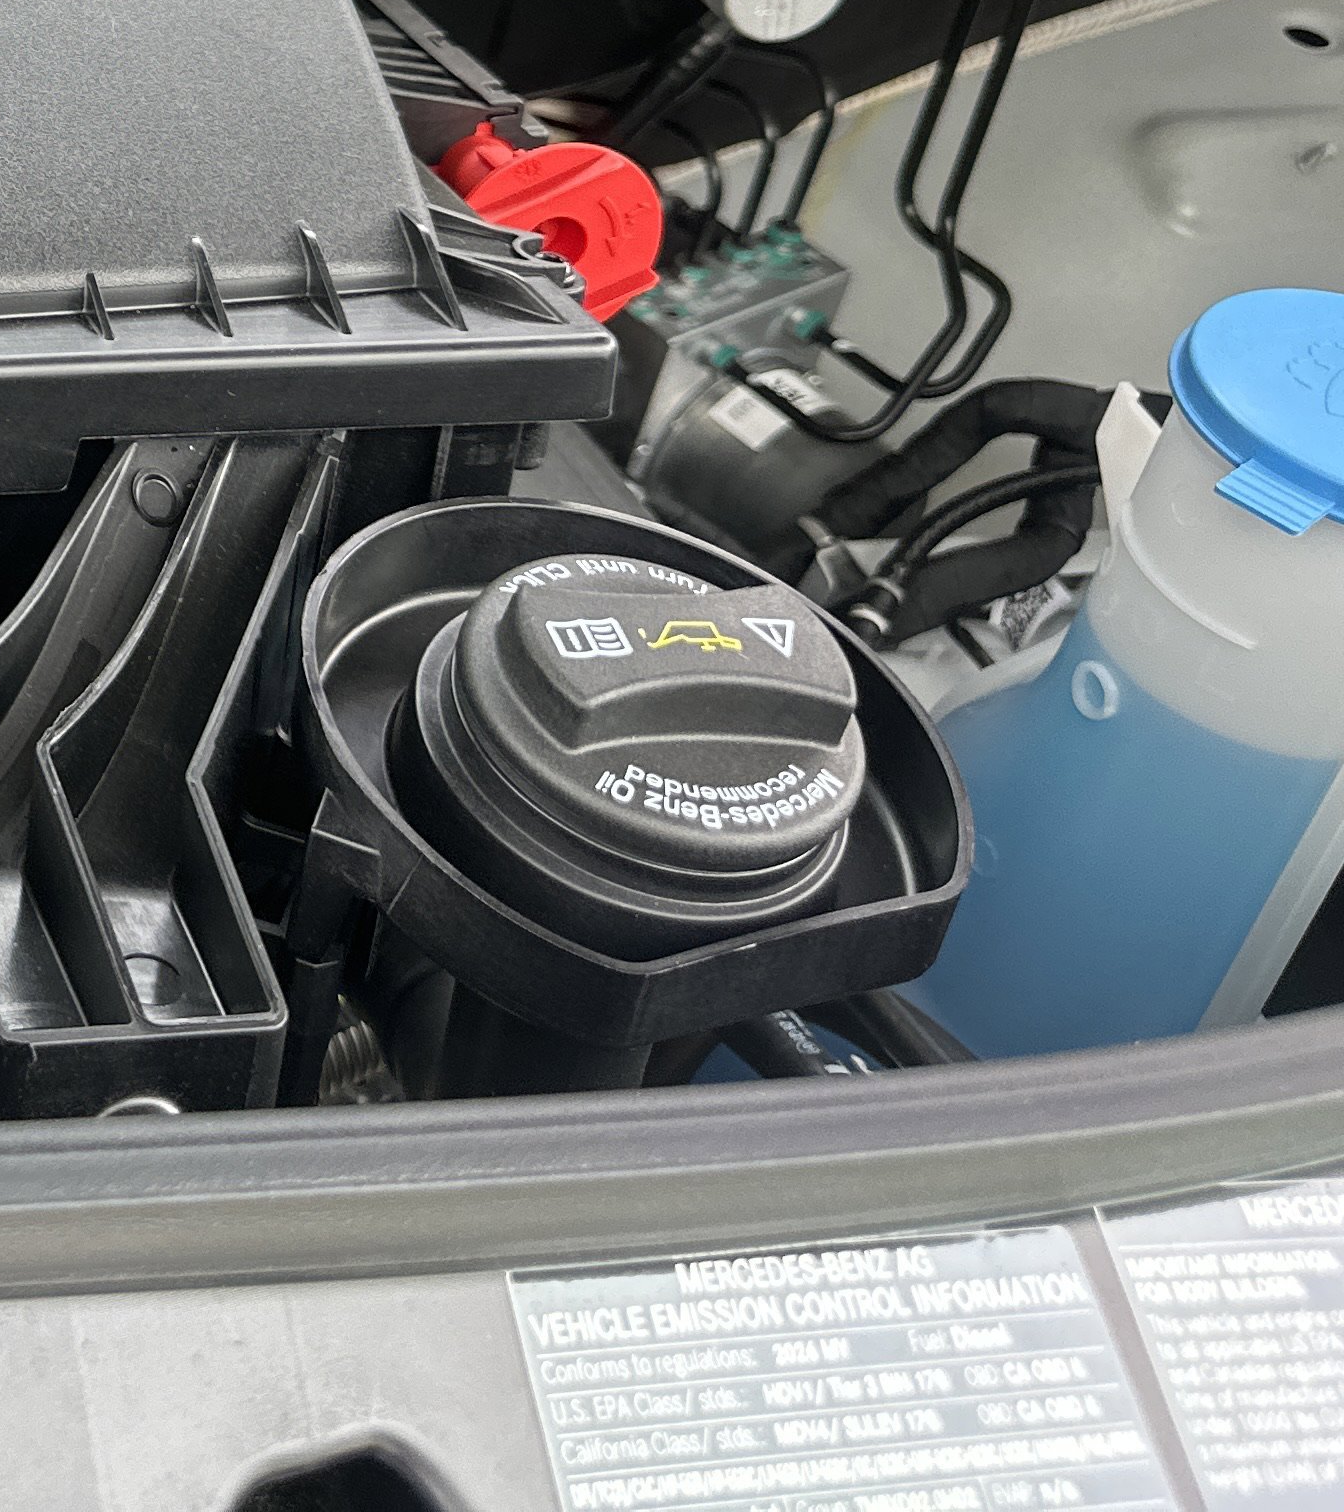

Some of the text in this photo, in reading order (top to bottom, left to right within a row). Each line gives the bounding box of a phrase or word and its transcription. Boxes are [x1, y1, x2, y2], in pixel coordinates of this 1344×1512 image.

[576, 559, 638, 576] until
[595, 768, 845, 829] Mercedes-Benz Oil
[624, 764, 806, 802] recommended
[1238, 1194, 1344, 1227] MERCED
[674, 1246, 935, 1294] MERCEDES-BENZ AG
[527, 1273, 1089, 1347] VEHICLE EMISSION CONTROL INFORMATION
[540, 1357, 629, 1384] Conforms
[631, 1353, 653, 1376] to
[654, 1347, 757, 1378] regulations:
[949, 1322, 1012, 1350] Diesel
[549, 1401, 590, 1424] U.S.
[594, 1395, 633, 1419] EPA
[560, 1436, 649, 1465] California
